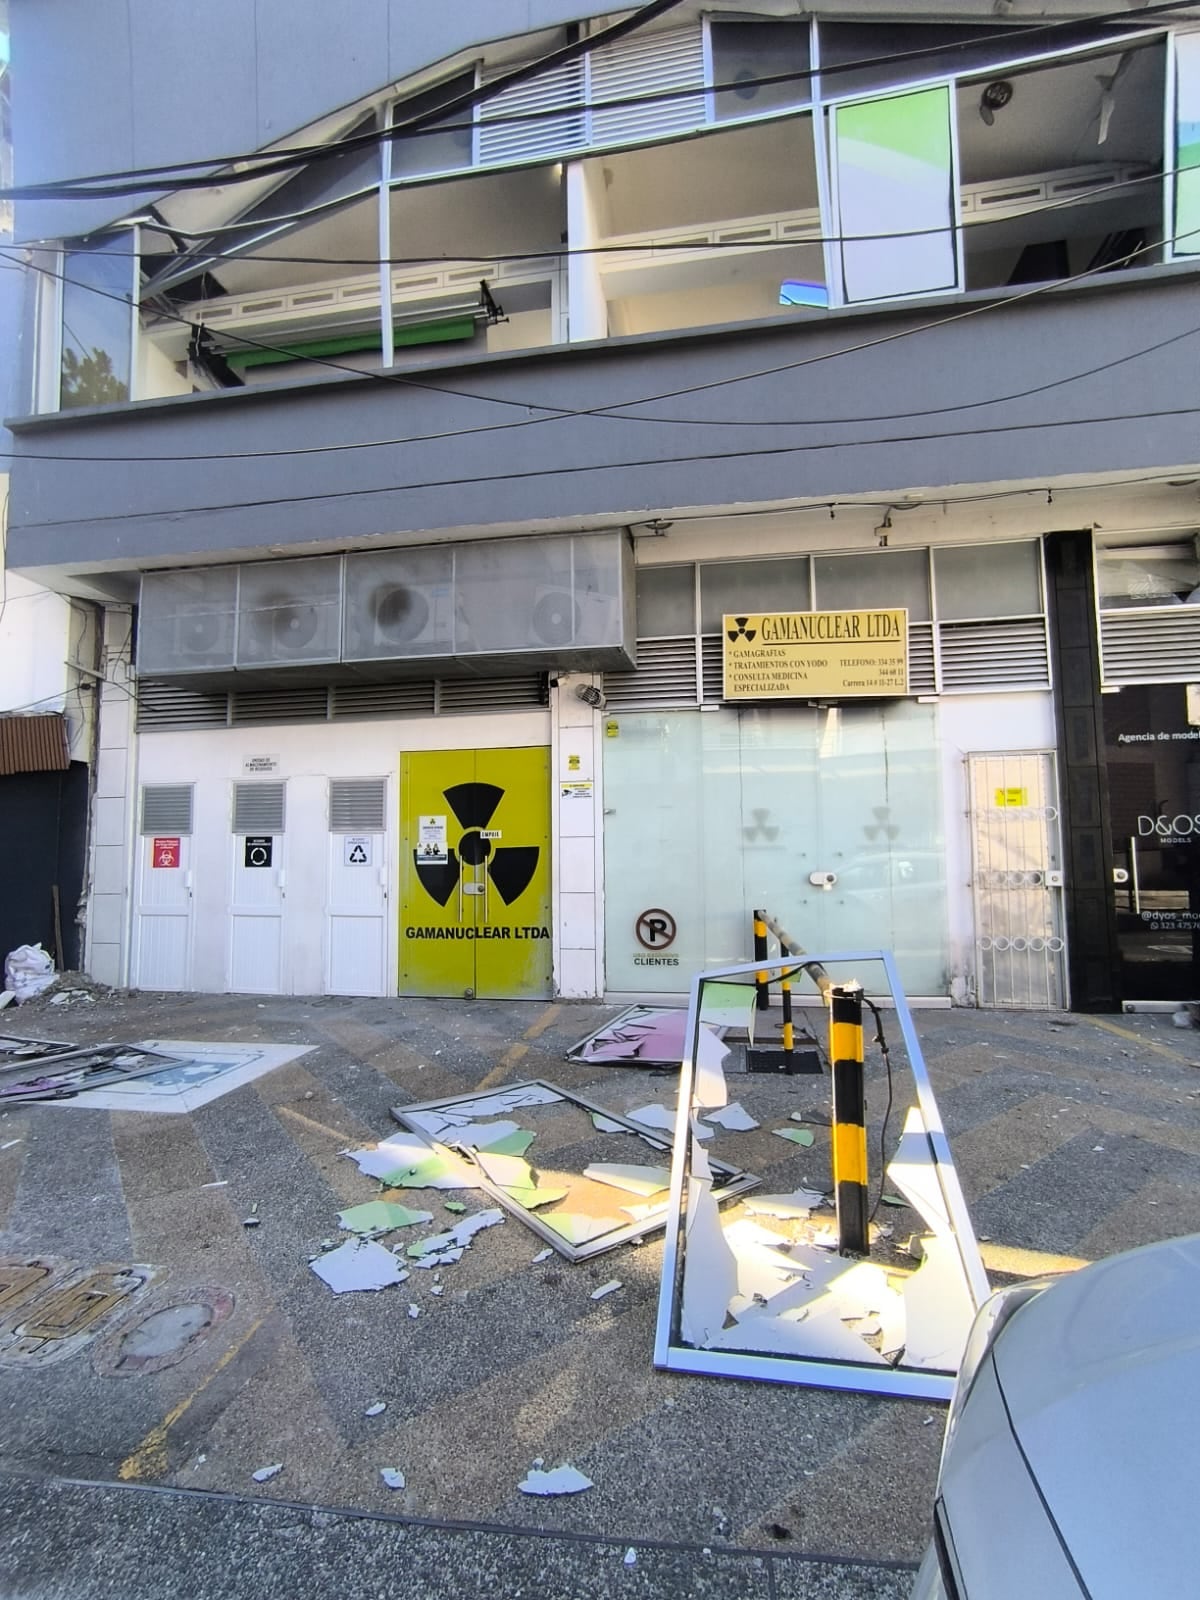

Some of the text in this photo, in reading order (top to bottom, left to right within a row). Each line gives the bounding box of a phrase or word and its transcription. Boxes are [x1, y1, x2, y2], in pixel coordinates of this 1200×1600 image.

[761, 613, 900, 641] GAMANUCLEAR LTDA
[733, 648, 786, 658] GAMAGRAFIAS
[734, 660, 788, 670] TRATAMIENTOS
[789, 660, 805, 668] CON
[733, 672, 808, 681] CONSULTA MEDICINA
[734, 683, 790, 692] ESPECIALIZADA
[842, 679, 865, 687] Carrera
[1118, 732, 1155, 743] Agencia
[1157, 731, 1170, 740] de
[1141, 911, 1200, 922] @dyos_mo
[405, 926, 550, 939] GAMANUCLEAR LTDA
[633, 957, 680, 966] CLIENTES
